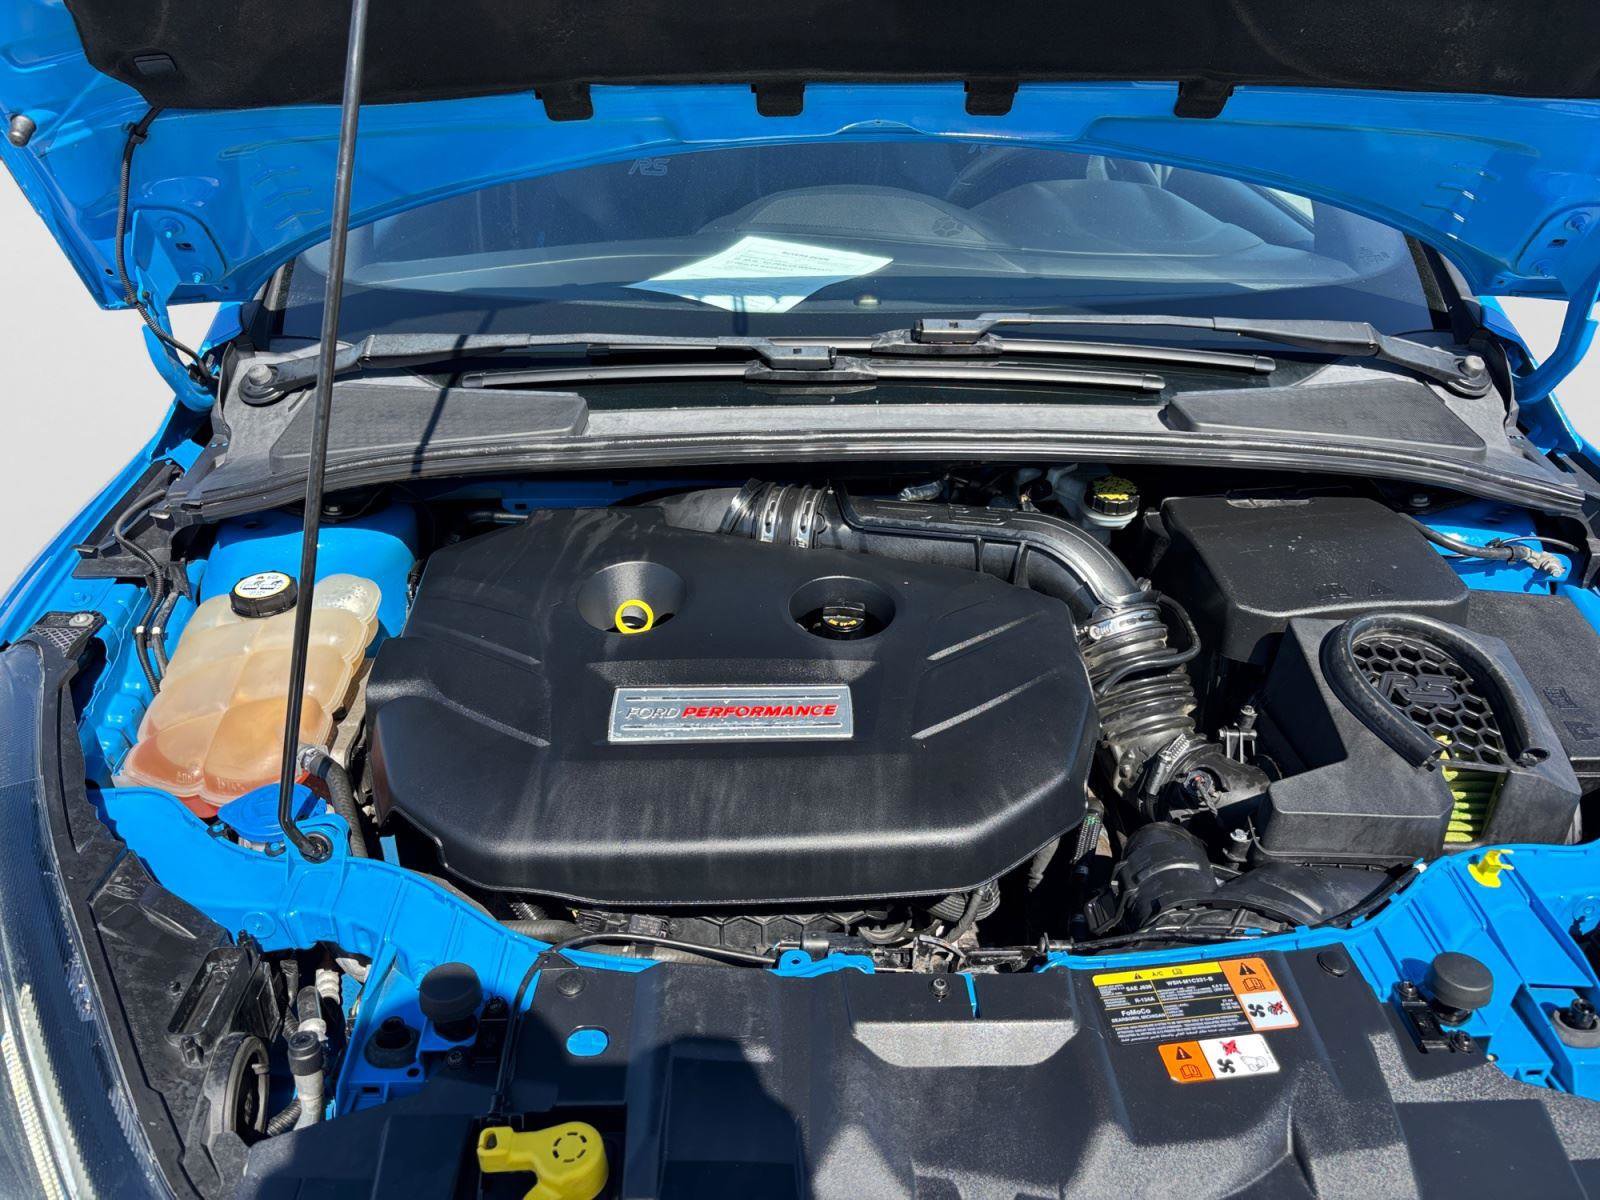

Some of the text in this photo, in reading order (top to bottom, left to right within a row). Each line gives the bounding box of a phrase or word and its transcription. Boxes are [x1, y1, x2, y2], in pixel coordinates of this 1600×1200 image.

[1379, 670, 1460, 704] RS
[626, 703, 839, 720] FORD PERFORMANCE
[1121, 1008, 1151, 1017] FoMoCo
